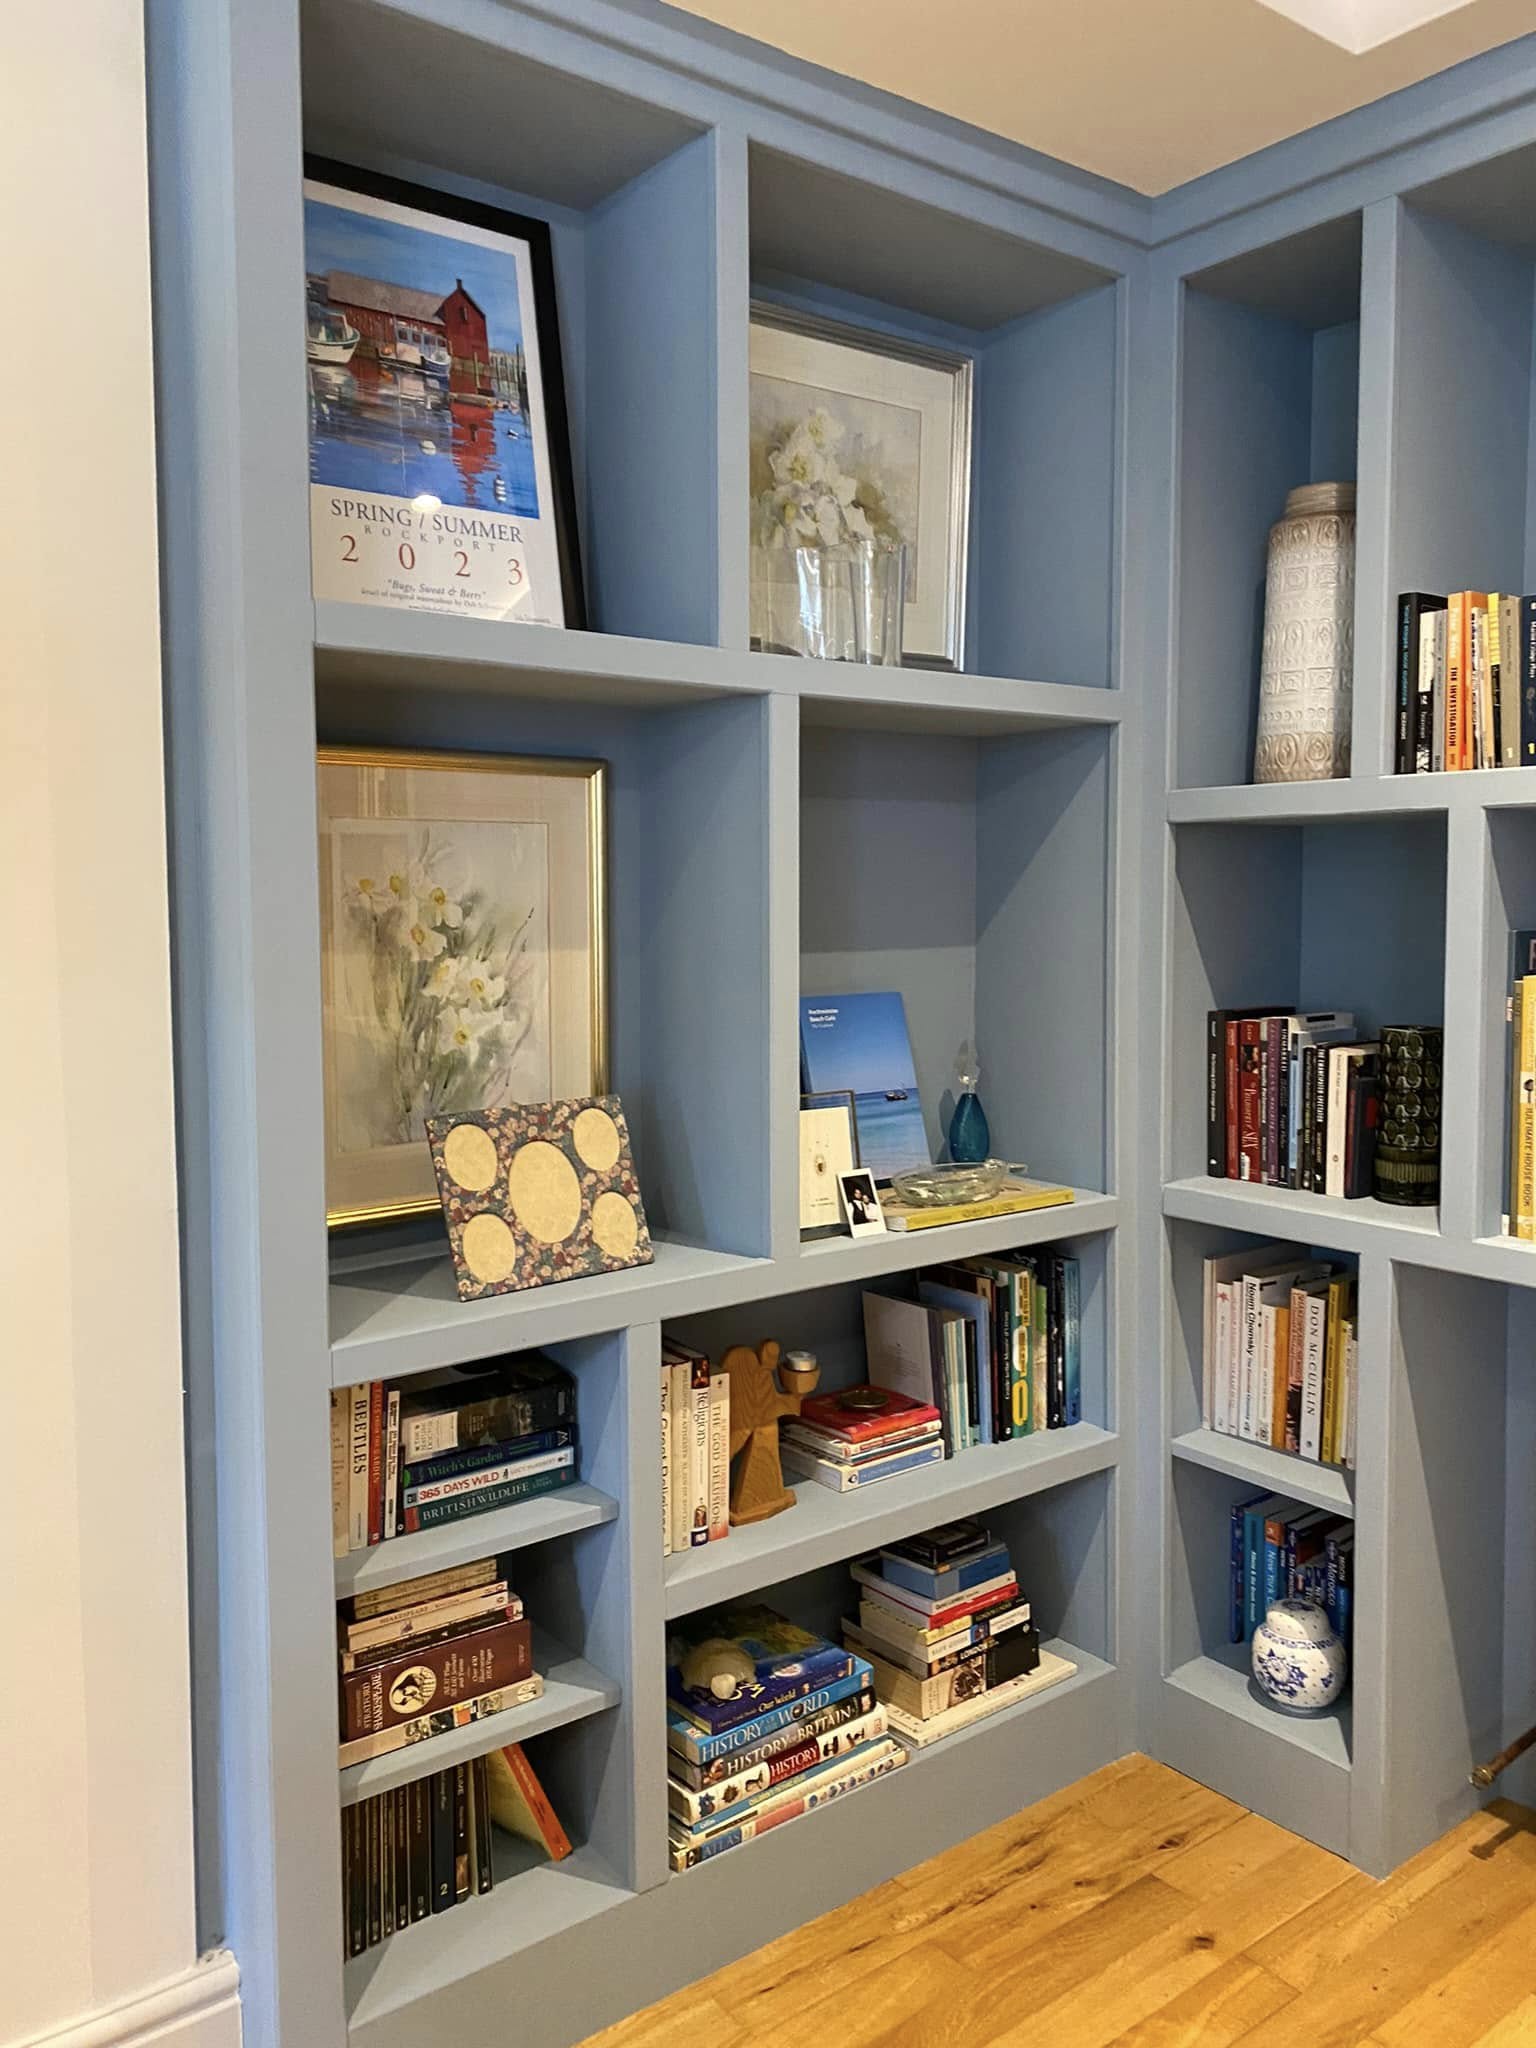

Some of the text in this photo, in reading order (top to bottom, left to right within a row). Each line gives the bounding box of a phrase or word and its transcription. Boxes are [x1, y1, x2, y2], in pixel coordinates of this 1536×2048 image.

[331, 498, 412, 526] SPRING
[433, 514, 524, 544] SUMMER
[364, 525, 497, 553] ROCKPORT
[340, 535, 523, 585] 2023
[1449, 667, 1458, 747] THE INVESTIGATION
[1317, 1095, 1325, 1122] SPECTATOR
[1241, 1130, 1258, 1150] SEX
[1522, 1111, 1534, 1208] ULTIMATE HOUSE BOOK
[1246, 1282, 1257, 1356] Noam Chomsky
[1306, 1304, 1319, 1416] DON McCULLIN
[354, 1399, 368, 1475] BEETLES
[695, 1391, 709, 1447] Religions
[419, 1471, 500, 1501] 365 DAYS WILD
[711, 1404, 721, 1526] THE GOD DELUSION
[422, 1482, 530, 1521] BRITISH WILDLIFE
[1266, 1550, 1277, 1595] New York
[1287, 1553, 1296, 1600] San Francisc
[1327, 1562, 1338, 1606] Morocco
[1338, 1555, 1346, 1581] MOON
[373, 1671, 383, 1731] SHAKESPEARE
[702, 1722, 763, 1763] HISTORY
[778, 1690, 831, 1723] WORLD
[727, 1738, 789, 1775] HISTORY
[797, 1705, 851, 1738] BRITAIN
[770, 1745, 818, 1776] HISTORY
[702, 1832, 741, 1860] ATLAS
[439, 1883, 448, 1896] 2
